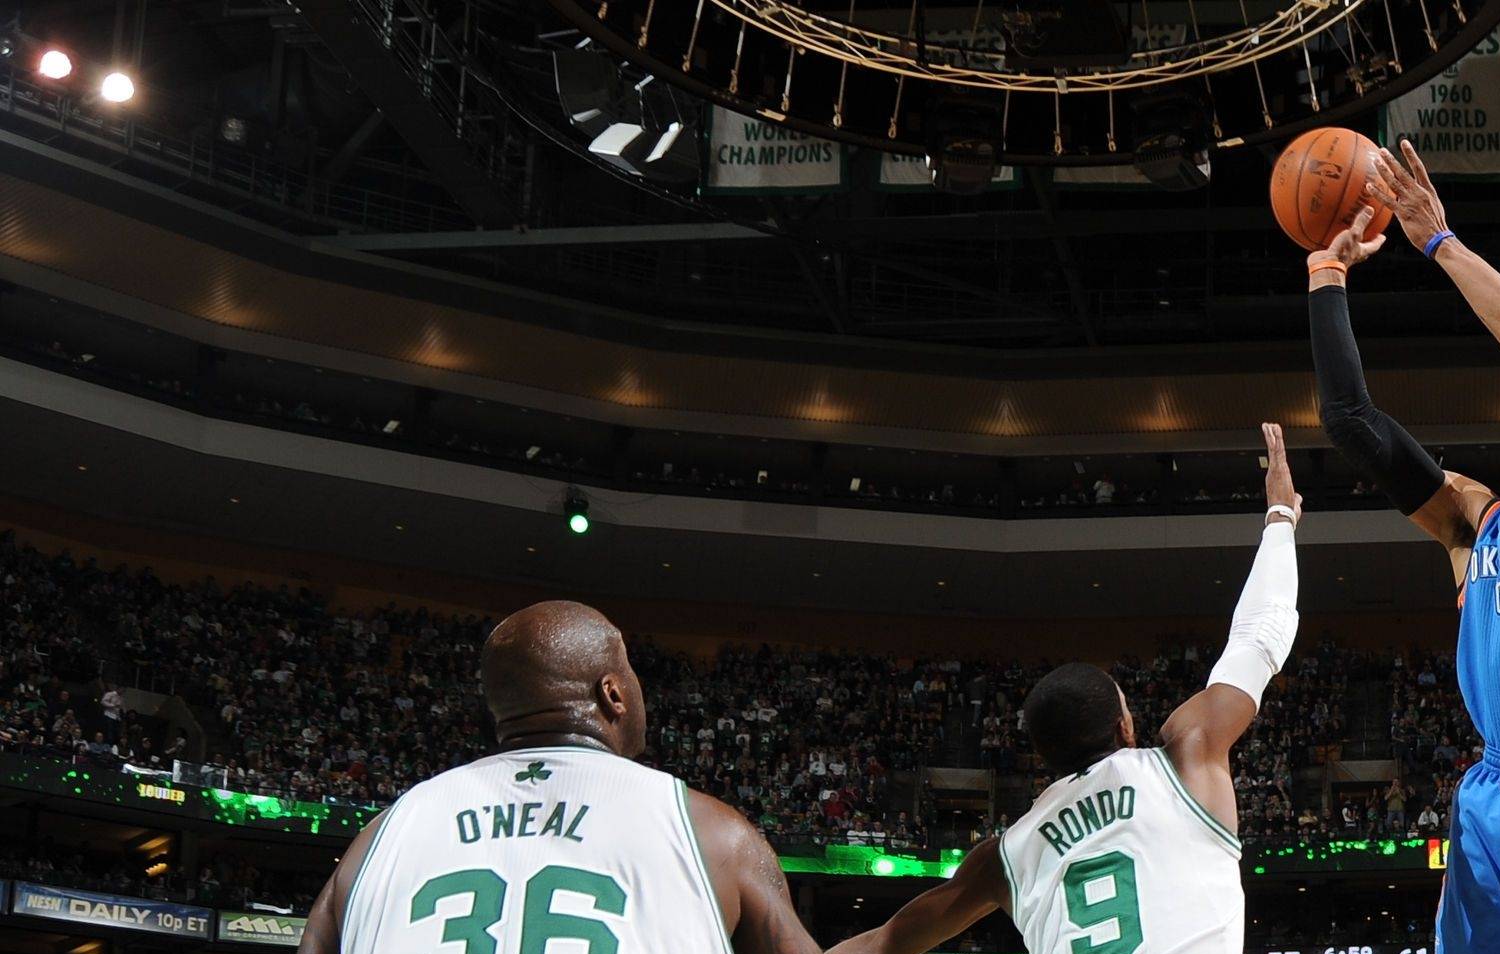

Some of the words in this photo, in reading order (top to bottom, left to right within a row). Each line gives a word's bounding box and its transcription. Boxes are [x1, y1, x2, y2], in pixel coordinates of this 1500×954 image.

[1430, 84, 1472, 103] 1960
[1418, 109, 1487, 128] WORLD
[718, 143, 832, 165] CHAMPIONS
[456, 801, 589, 844] O'NEAL
[1038, 785, 1135, 857] RONDO
[27, 895, 61, 911] NESN
[69, 899, 151, 924] DAILY
[156, 912, 183, 931] 10p
[187, 917, 207, 932] ET
